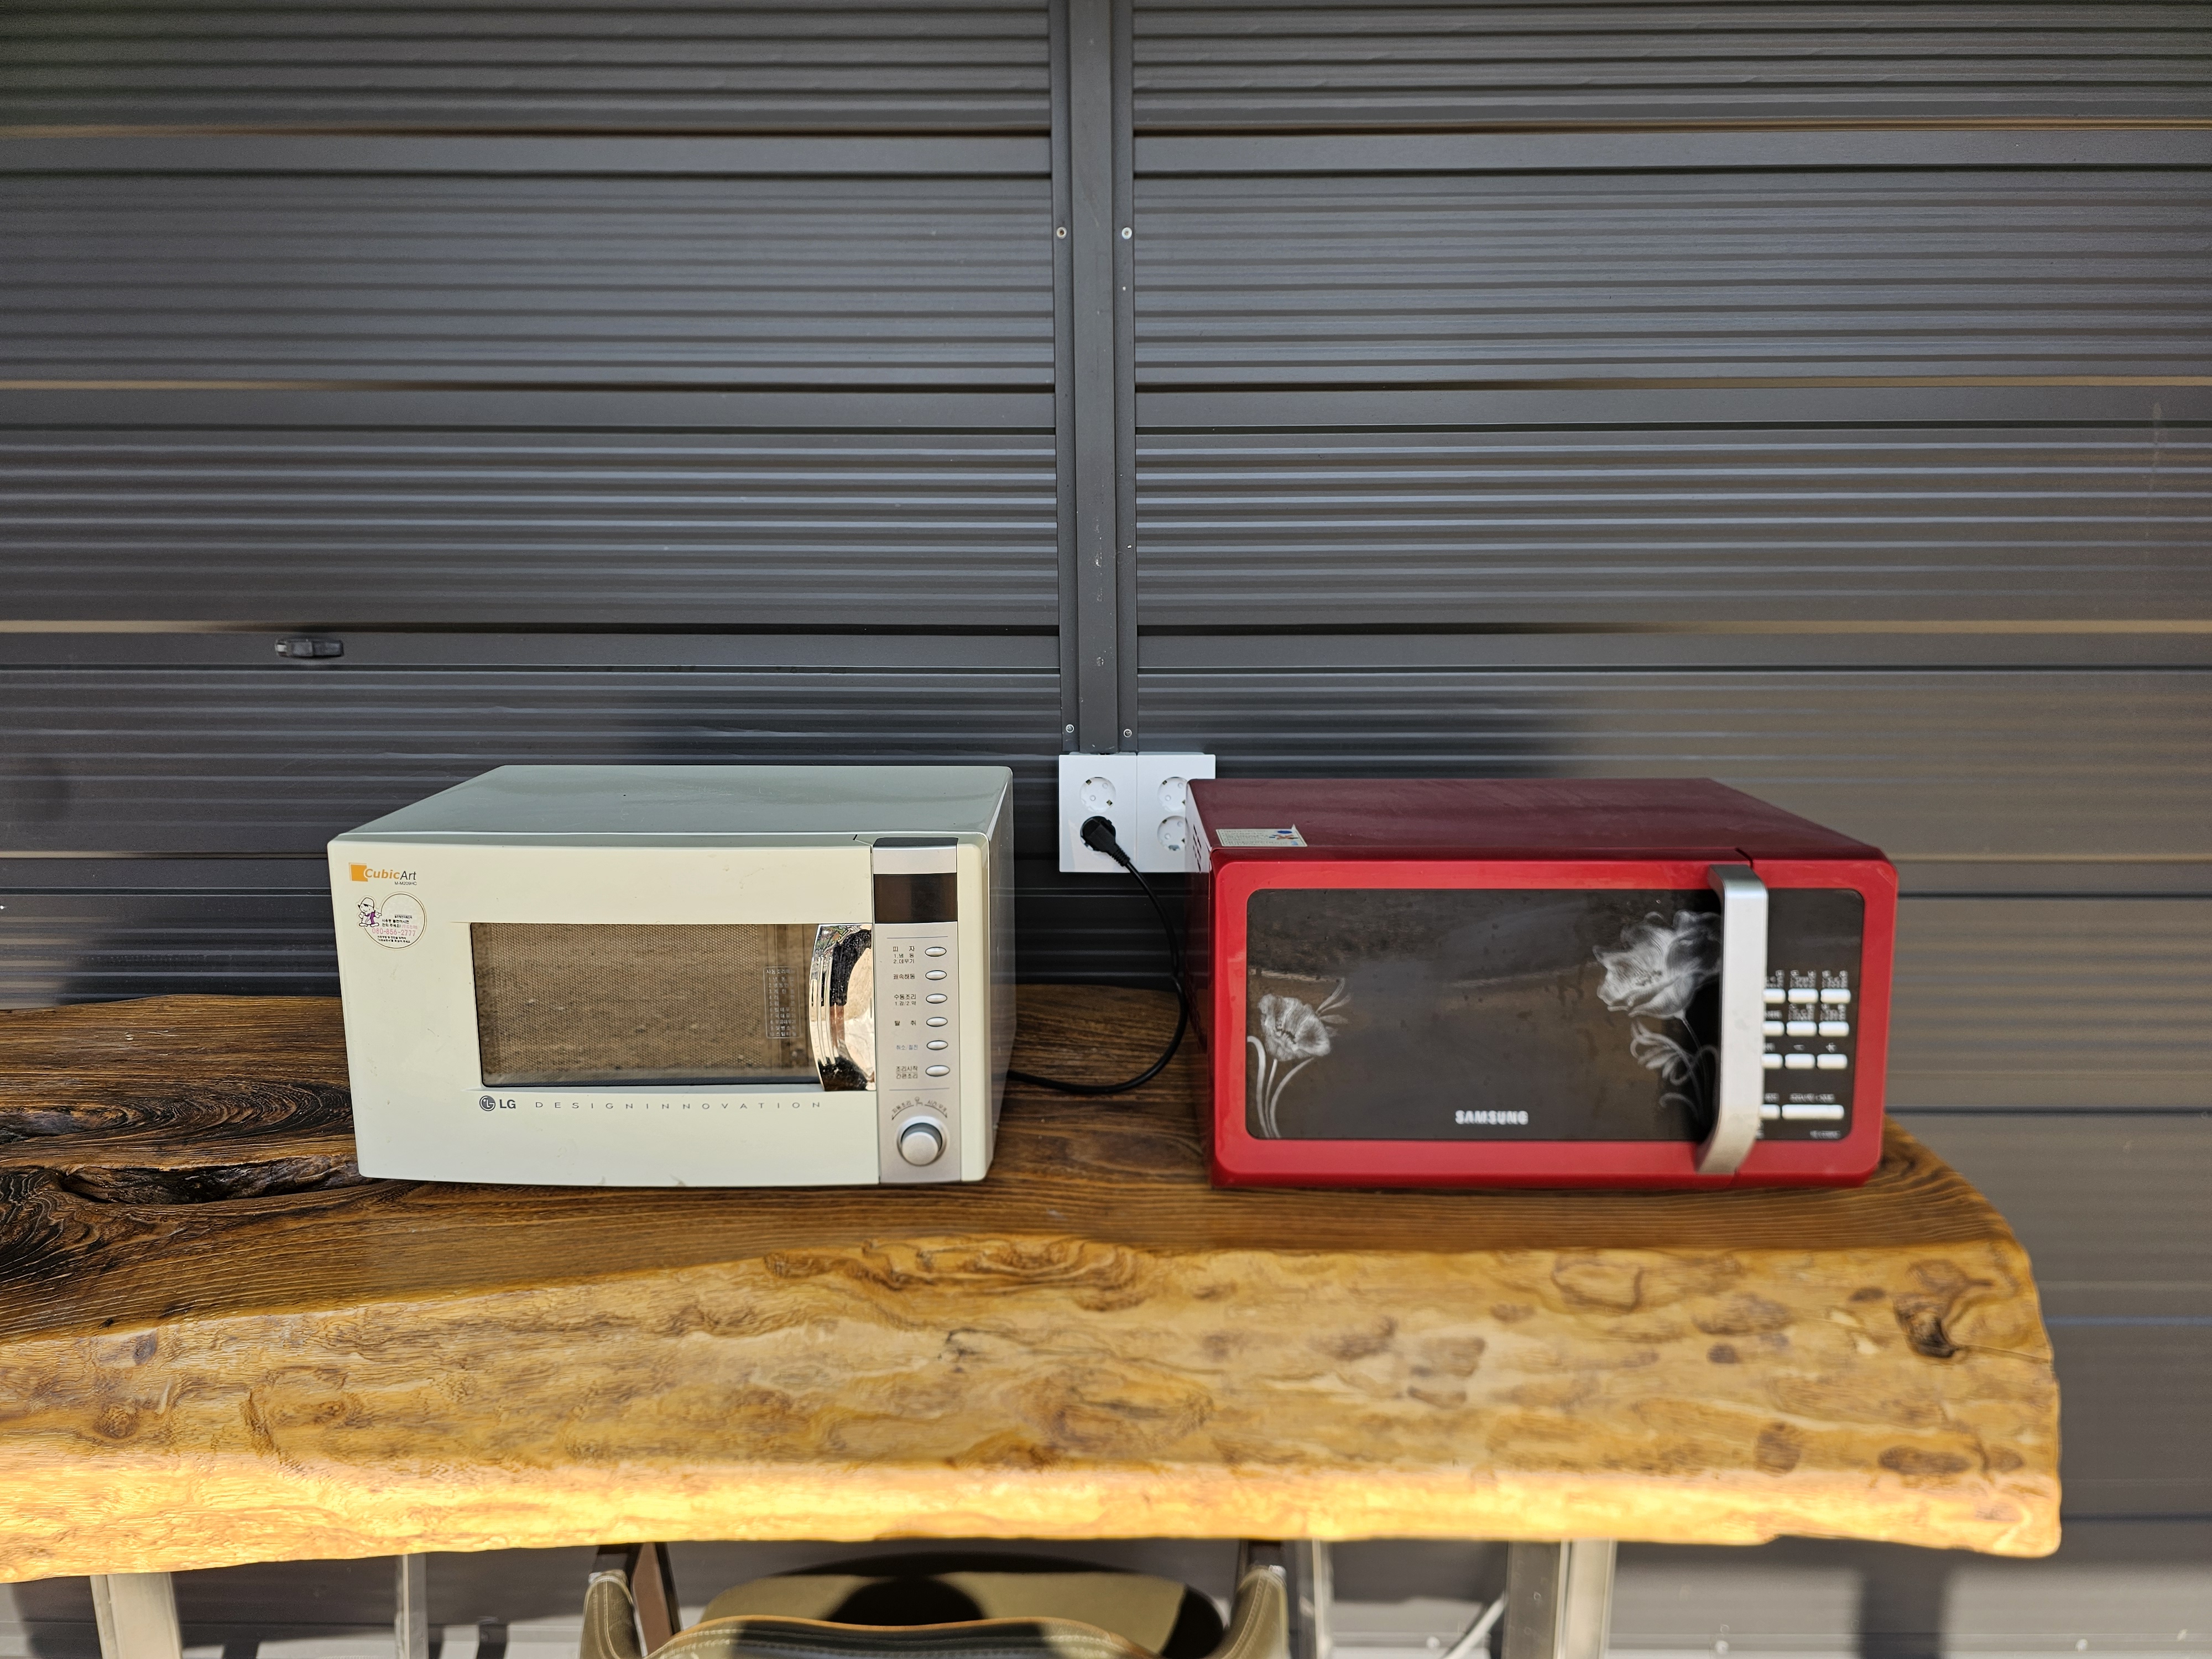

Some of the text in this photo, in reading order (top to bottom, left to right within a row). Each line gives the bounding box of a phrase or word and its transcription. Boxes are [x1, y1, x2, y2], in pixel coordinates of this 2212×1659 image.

[372, 927, 416, 936] 080-856-2777
[499, 1099, 516, 1109] LG
[1455, 1110, 1528, 1125] SAMSUNG
